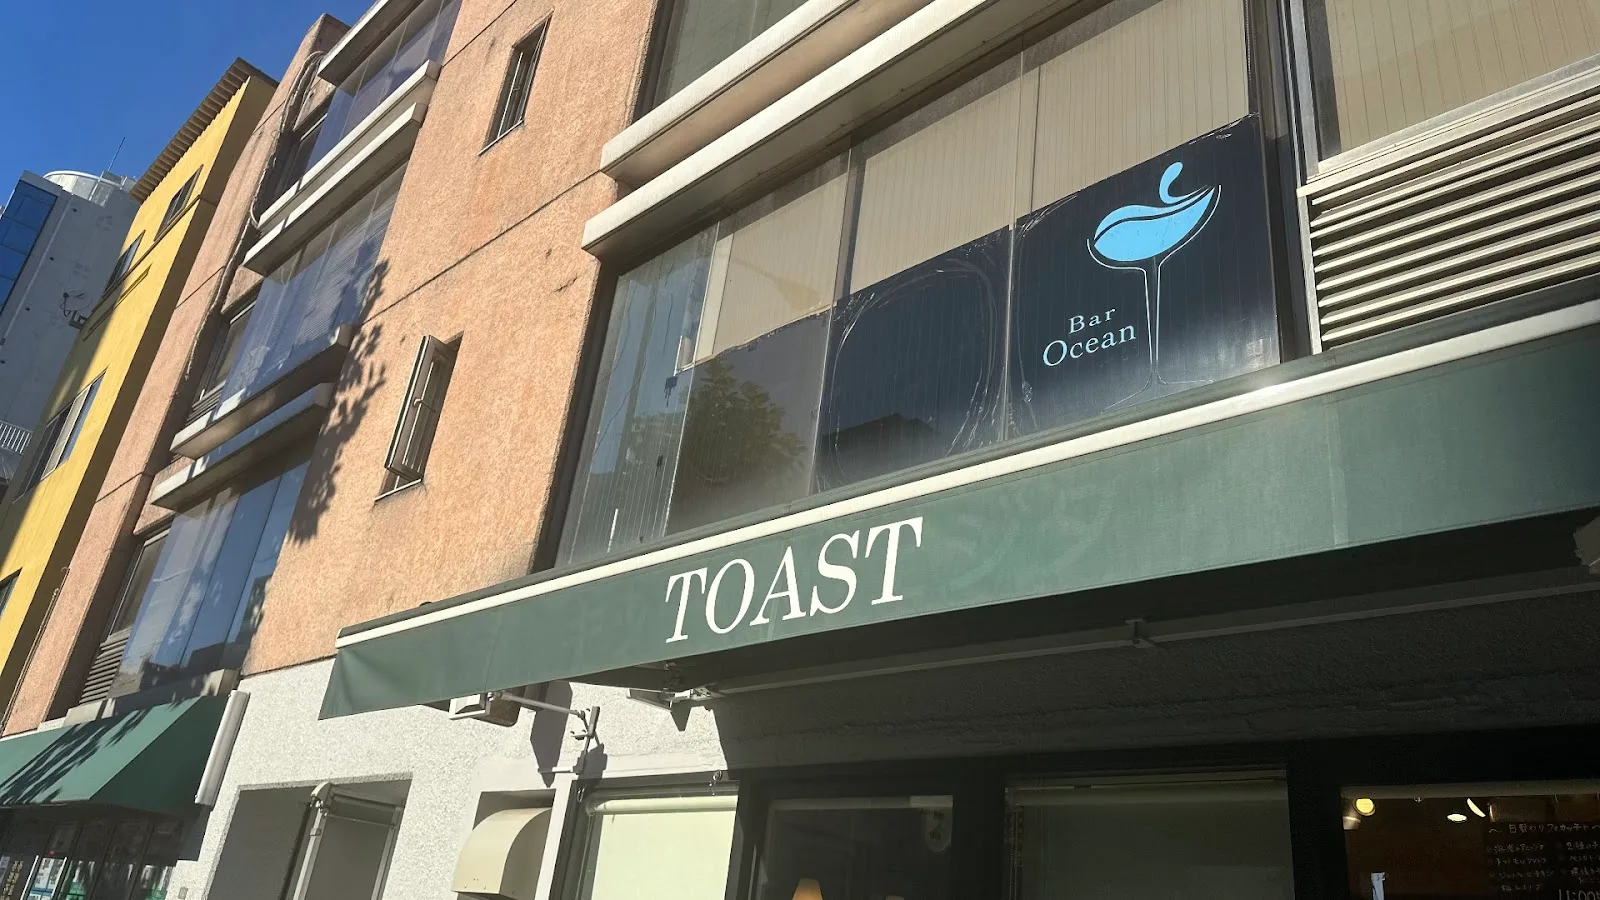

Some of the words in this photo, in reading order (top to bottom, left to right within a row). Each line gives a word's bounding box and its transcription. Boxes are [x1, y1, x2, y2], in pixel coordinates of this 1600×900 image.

[1068, 308, 1116, 335] Bar
[1042, 324, 1136, 367] Ocean
[665, 516, 923, 644] TOAST
